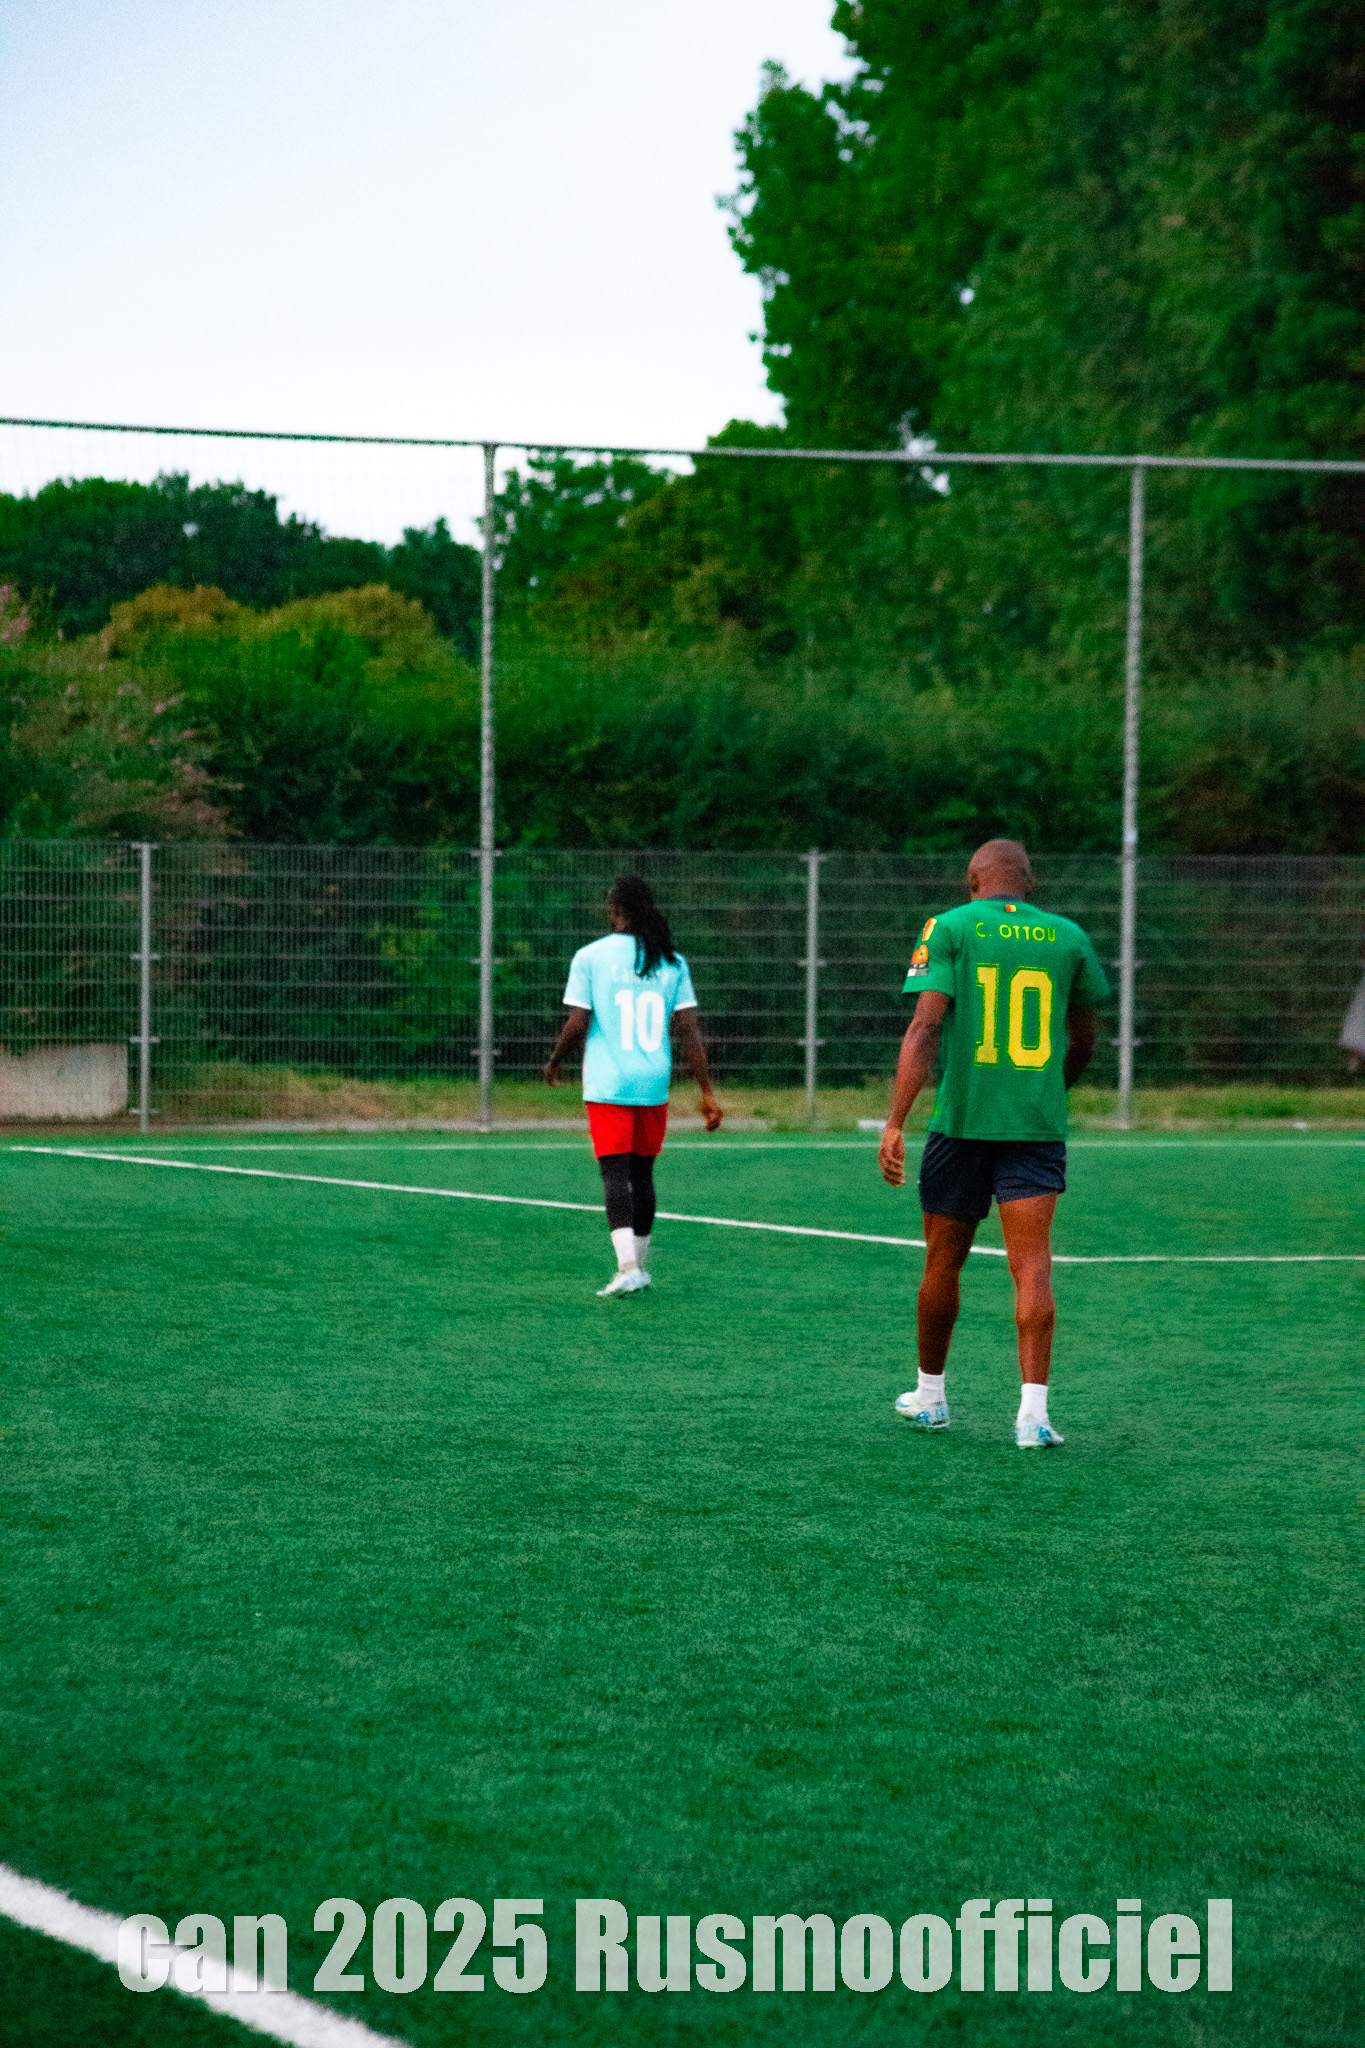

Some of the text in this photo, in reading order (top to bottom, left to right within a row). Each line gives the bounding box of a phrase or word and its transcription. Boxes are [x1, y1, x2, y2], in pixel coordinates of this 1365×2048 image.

[975, 921, 1056, 942] C. OTTOU
[615, 989, 665, 1053] 10
[974, 962, 1054, 1071] 10
